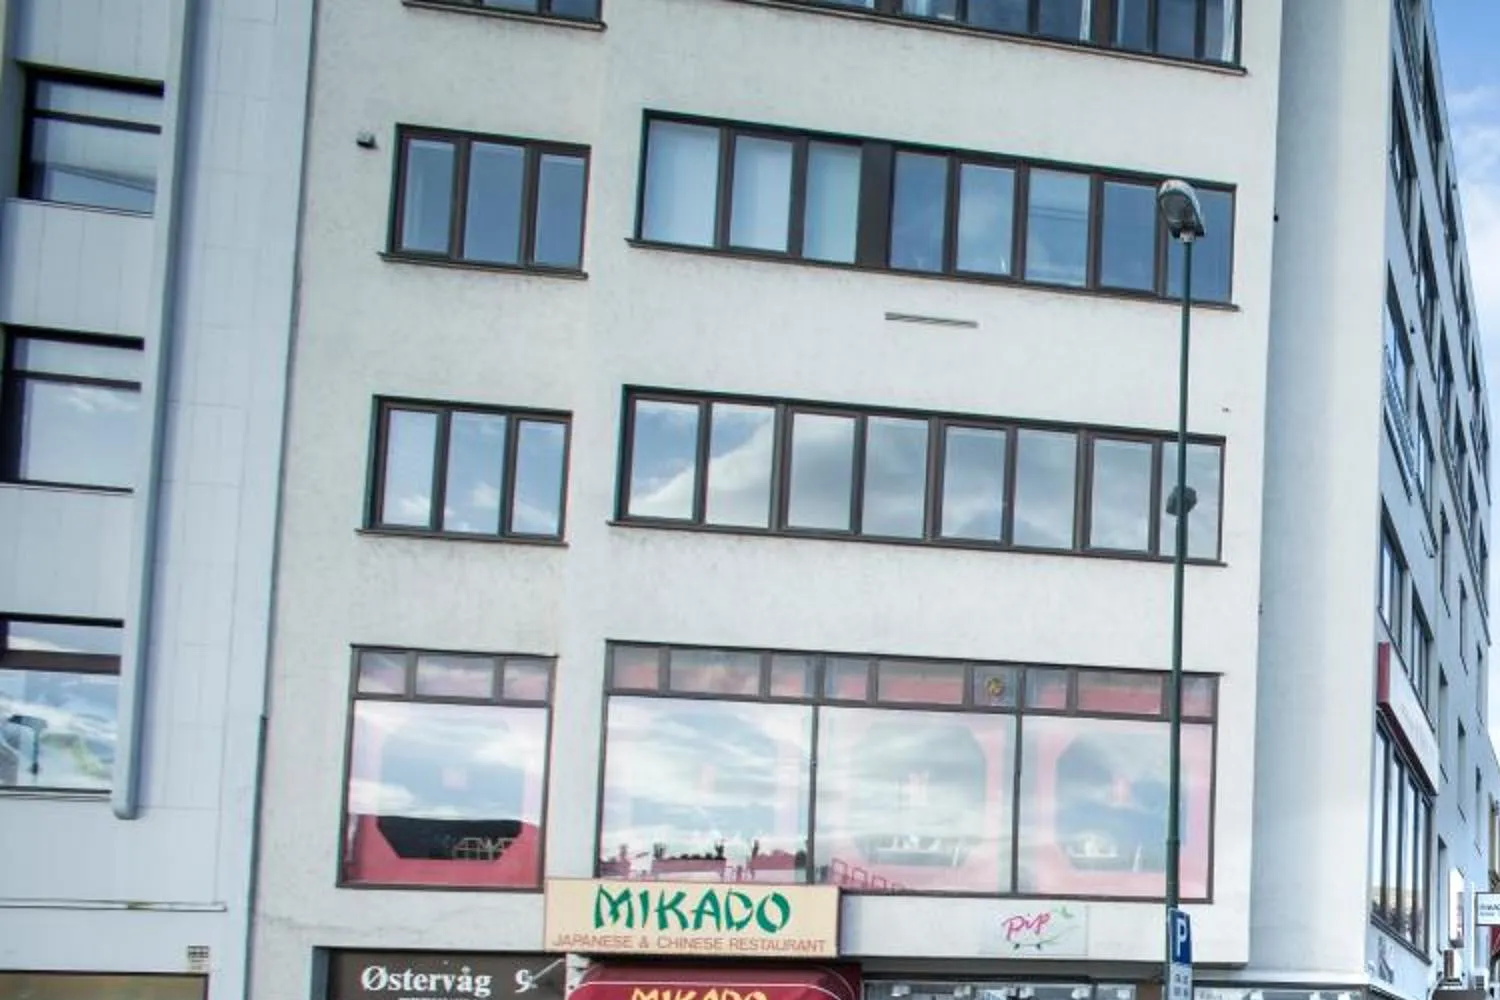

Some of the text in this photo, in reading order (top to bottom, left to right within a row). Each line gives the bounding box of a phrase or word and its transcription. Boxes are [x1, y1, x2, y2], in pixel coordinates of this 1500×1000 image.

[593, 884, 791, 934] MIKADO
[552, 932, 827, 953] JAPANESE & CHINESE RESTAURANT
[1176, 917, 1188, 958] P
[361, 964, 493, 997] Østervåg
